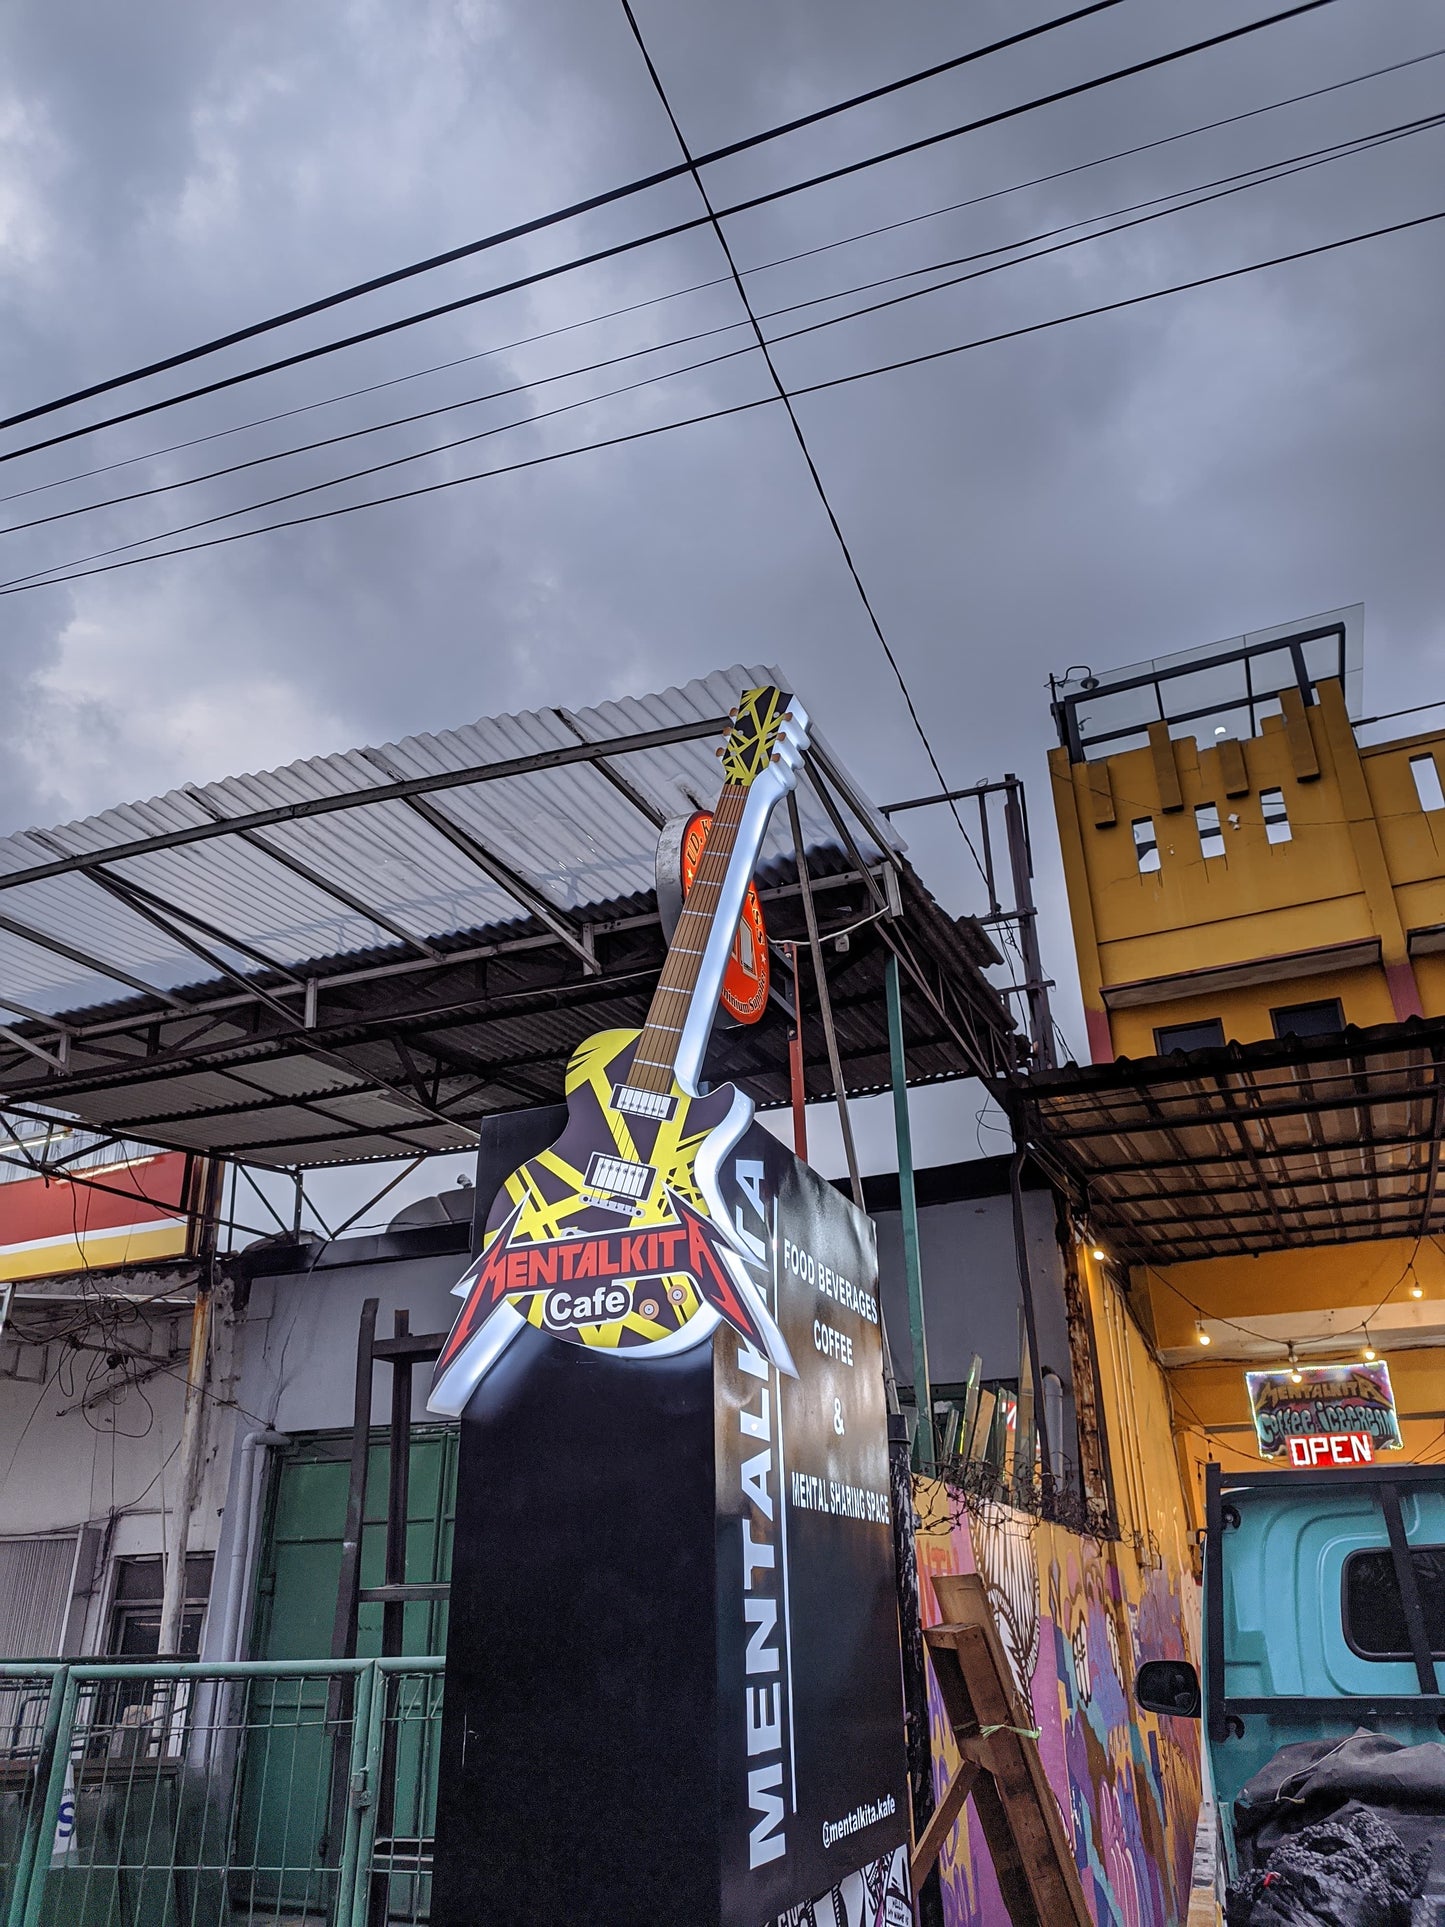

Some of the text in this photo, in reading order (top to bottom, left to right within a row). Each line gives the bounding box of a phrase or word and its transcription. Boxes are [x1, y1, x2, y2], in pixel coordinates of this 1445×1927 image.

[441, 1209, 753, 1368] MENTALKITA
[550, 1285, 626, 1321] Cafe
[784, 1238, 878, 1325] FOOD BEVERAGES
[814, 1319, 854, 1367] COFFEE
[1255, 1373, 1392, 1411] MENTALKITA
[834, 1397, 845, 1436] &
[1289, 1434, 1372, 1466] OPEN
[791, 1472, 890, 1525] MENTAL SHARING SPACE
[822, 1793, 895, 1849] @mentalkita.kafe
